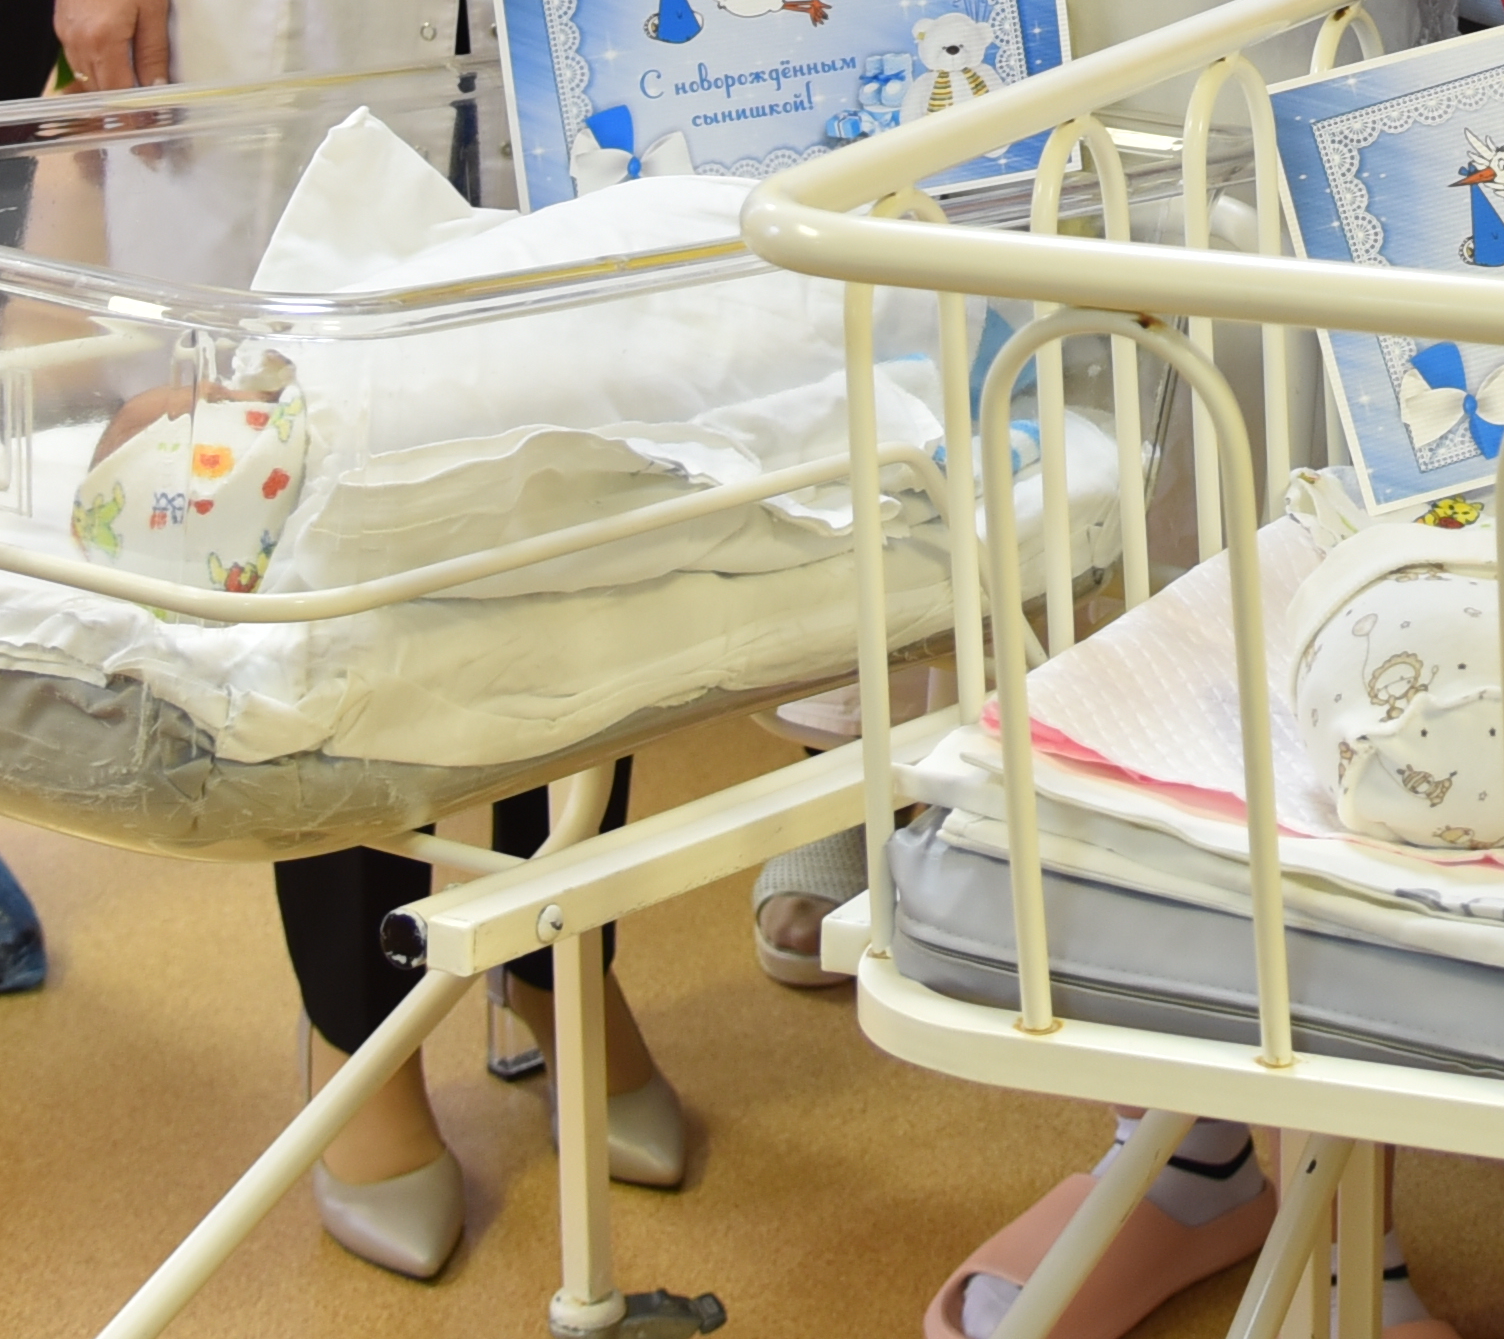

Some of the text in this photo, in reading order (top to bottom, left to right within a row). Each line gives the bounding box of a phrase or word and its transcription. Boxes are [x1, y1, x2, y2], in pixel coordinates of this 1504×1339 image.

[639, 56, 857, 99] С новорождённым
[691, 81, 814, 127] сынишкой!
